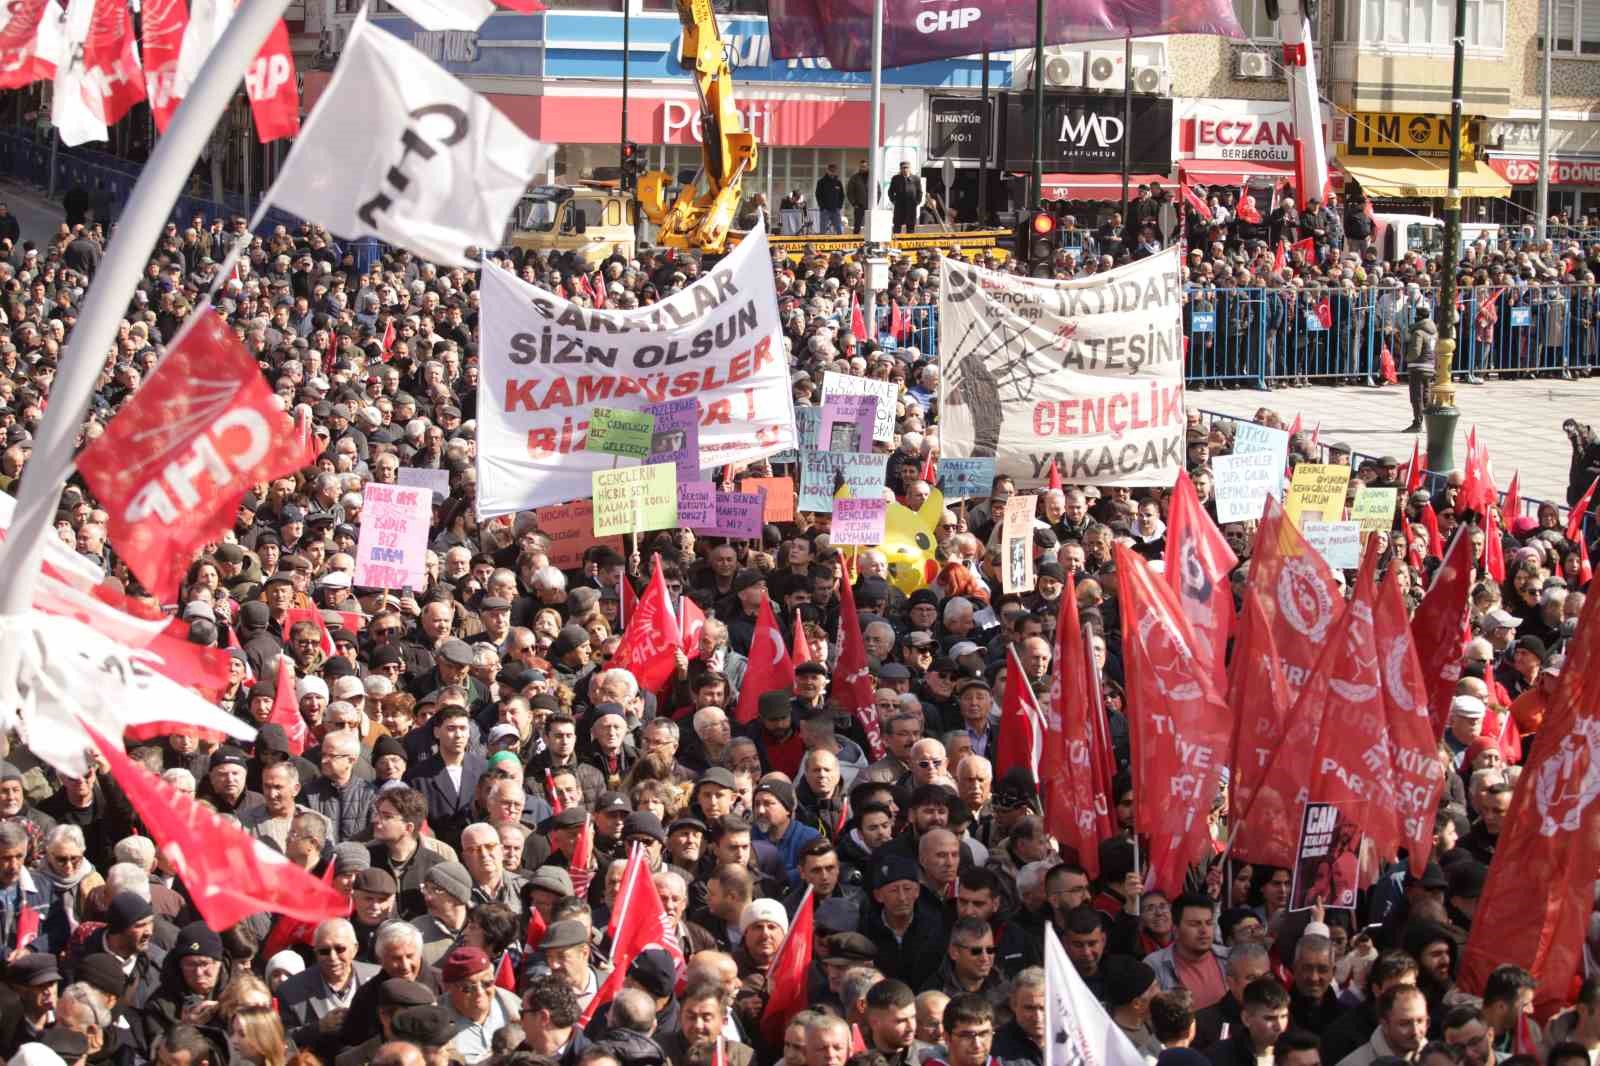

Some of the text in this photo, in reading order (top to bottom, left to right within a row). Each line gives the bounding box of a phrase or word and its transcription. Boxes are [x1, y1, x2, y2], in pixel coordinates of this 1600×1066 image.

[916, 8, 981, 33] CHP
[245, 54, 290, 100] HP
[1058, 112, 1124, 147] MAD
[632, 299, 759, 369] OLSUN
[1062, 318, 1183, 376] ATEŞİNİ
[1032, 381, 1184, 440] GENÇLİK
[124, 408, 272, 525] CHP
[1028, 436, 1184, 480] YAKACAK
[1306, 805, 1338, 834] CAN
